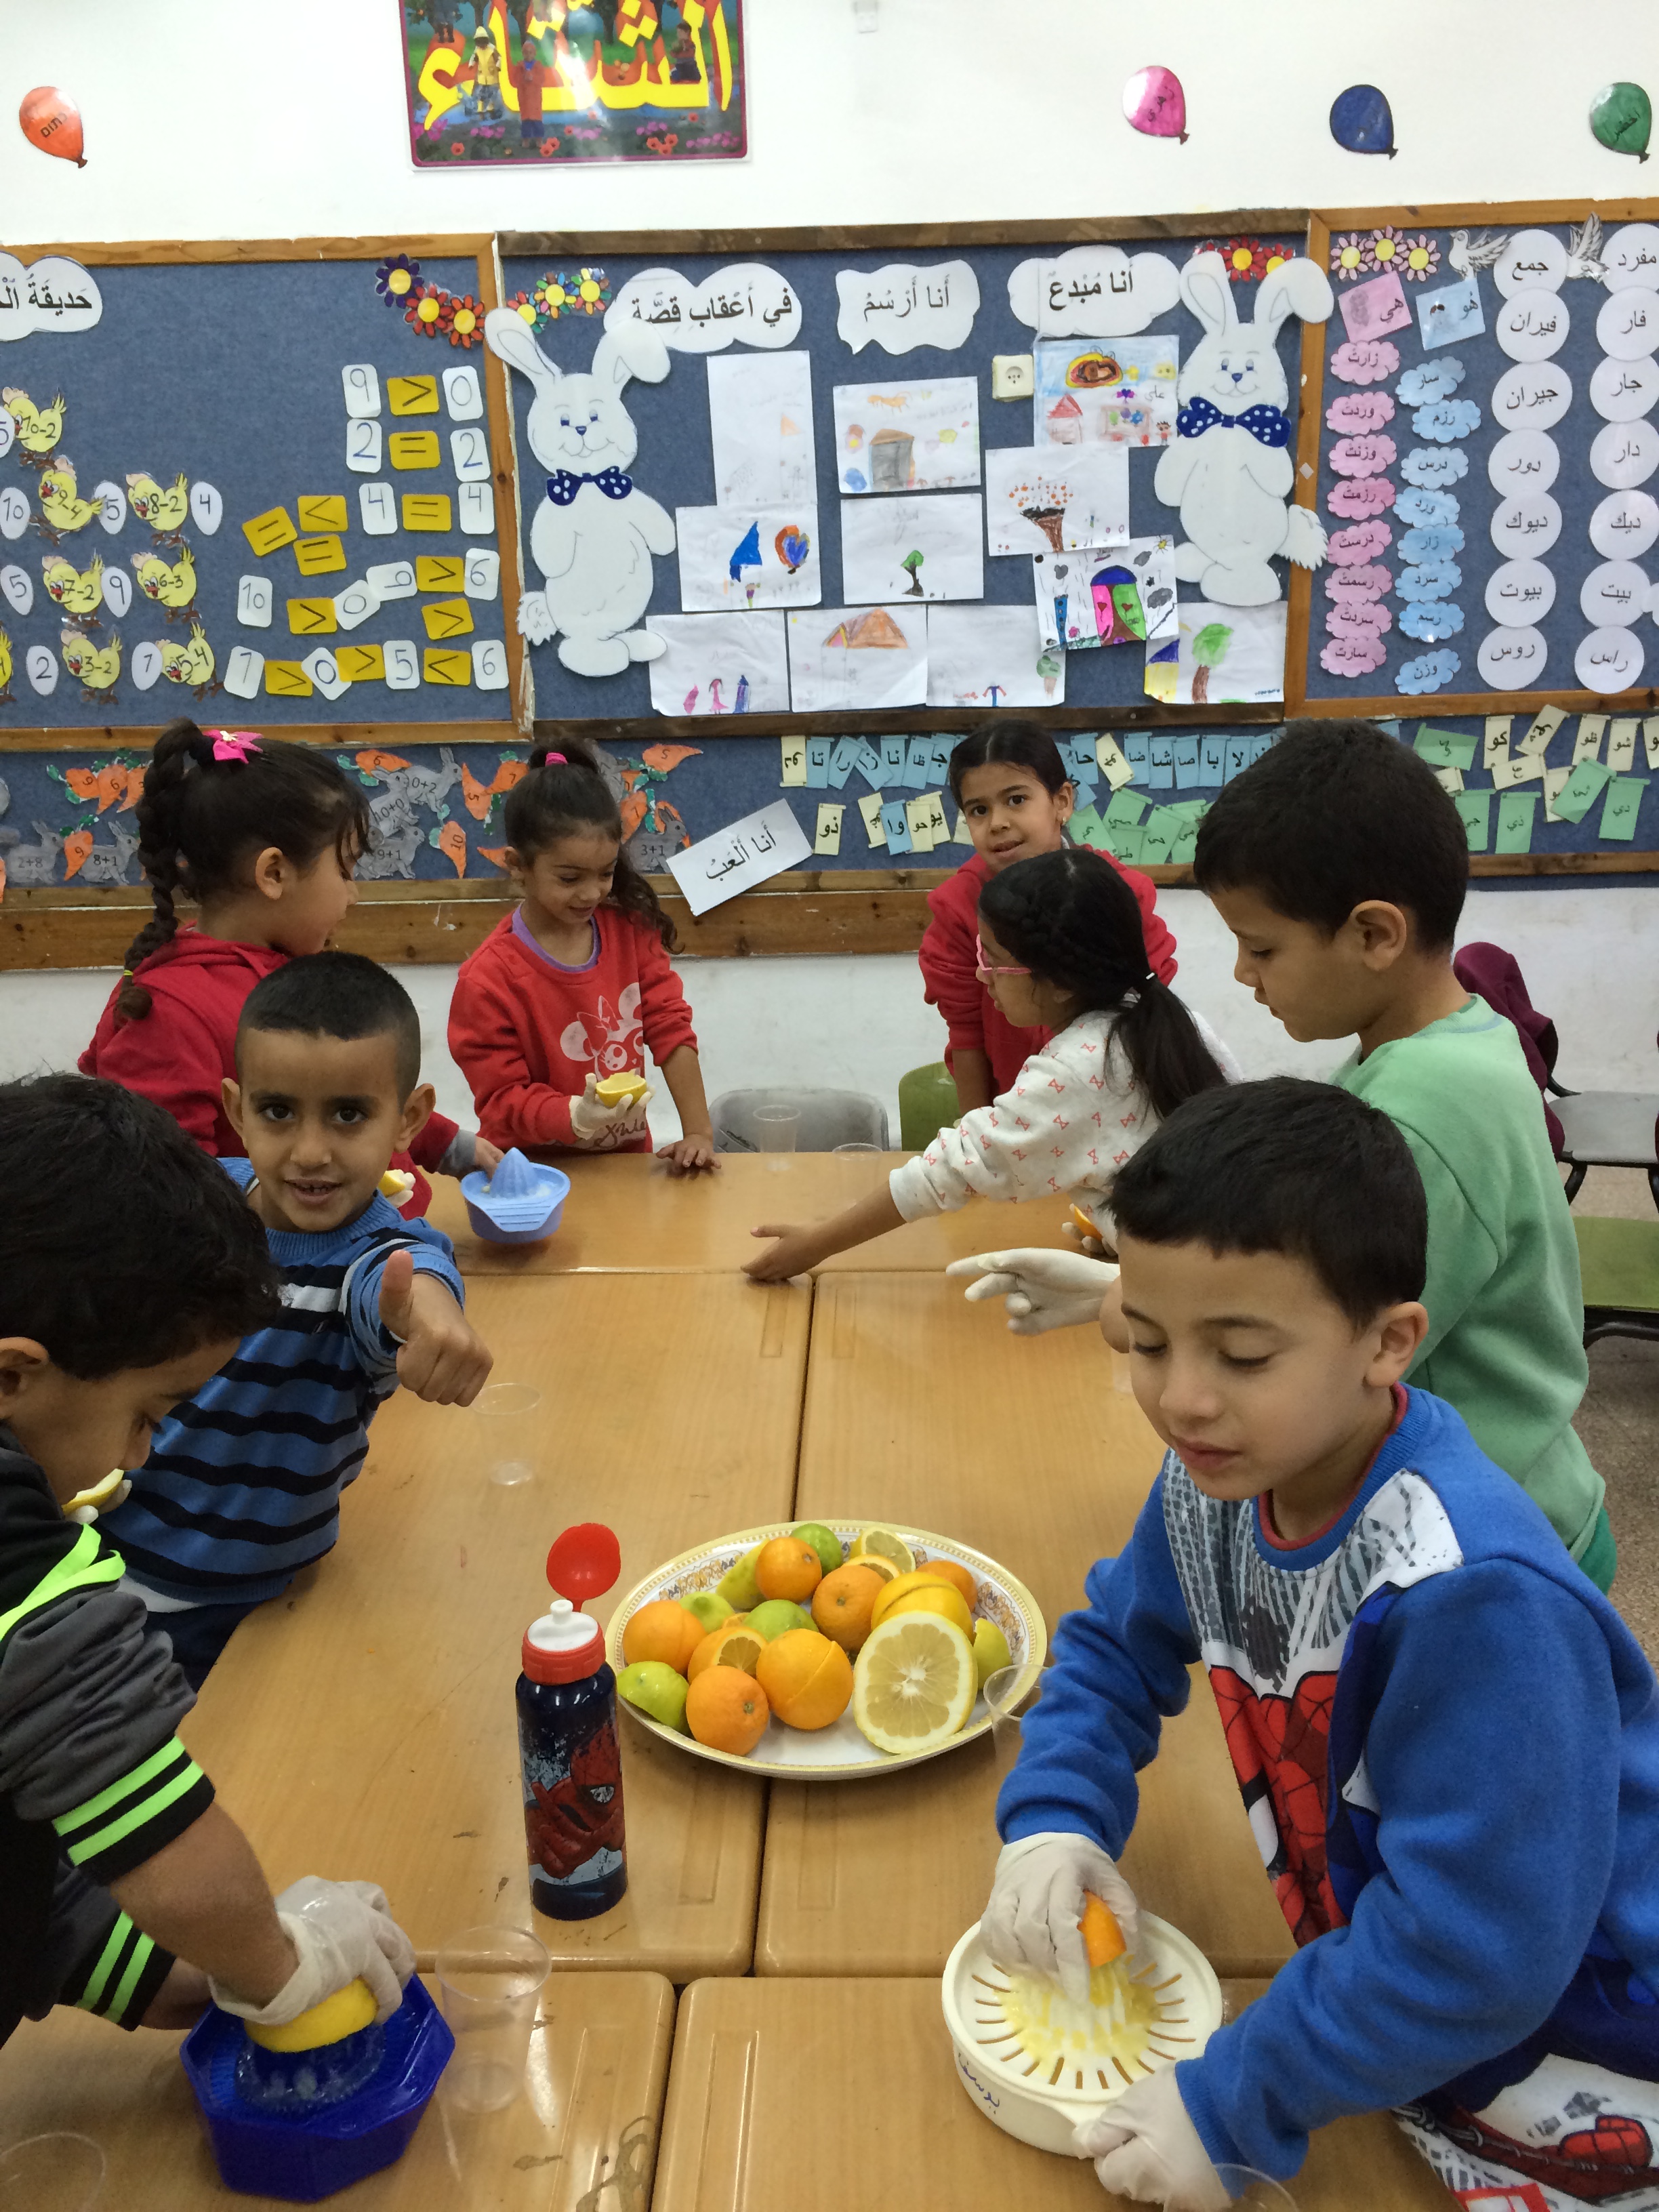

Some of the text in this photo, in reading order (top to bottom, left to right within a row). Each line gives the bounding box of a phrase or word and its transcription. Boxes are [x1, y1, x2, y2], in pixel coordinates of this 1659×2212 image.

[1512, 261, 1549, 281] جمع
[1618, 248, 1658, 272] مفرد
[763, 287, 792, 328] في
[1510, 311, 1557, 337] فيران
[1620, 310, 1647, 335] فار
[350, 368, 370, 402] 9
[451, 375, 472, 407] 0
[1611, 373, 1643, 397] جار
[1507, 386, 1559, 410] جيران
[353, 422, 377, 459] 2
[459, 432, 483, 468] 2
[1614, 441, 1640, 464] دار
[1507, 458, 1541, 474] دور
[104, 498, 121, 520] 5
[200, 494, 211, 515] 4
[367, 486, 385, 519] 4
[468, 485, 482, 512] 4
[1506, 512, 1548, 534] ديوك
[1611, 512, 1641, 534] ديك
[470, 558, 490, 586] 6
[9, 575, 27, 598] 5
[109, 575, 125, 605] 9
[243, 582, 265, 609] 10
[1500, 583, 1542, 602] بيوت
[1601, 584, 1632, 604] بيت
[395, 649, 413, 680] 5
[482, 647, 495, 676] 6
[1490, 644, 1536, 662] روس
[36, 656, 52, 680] 2
